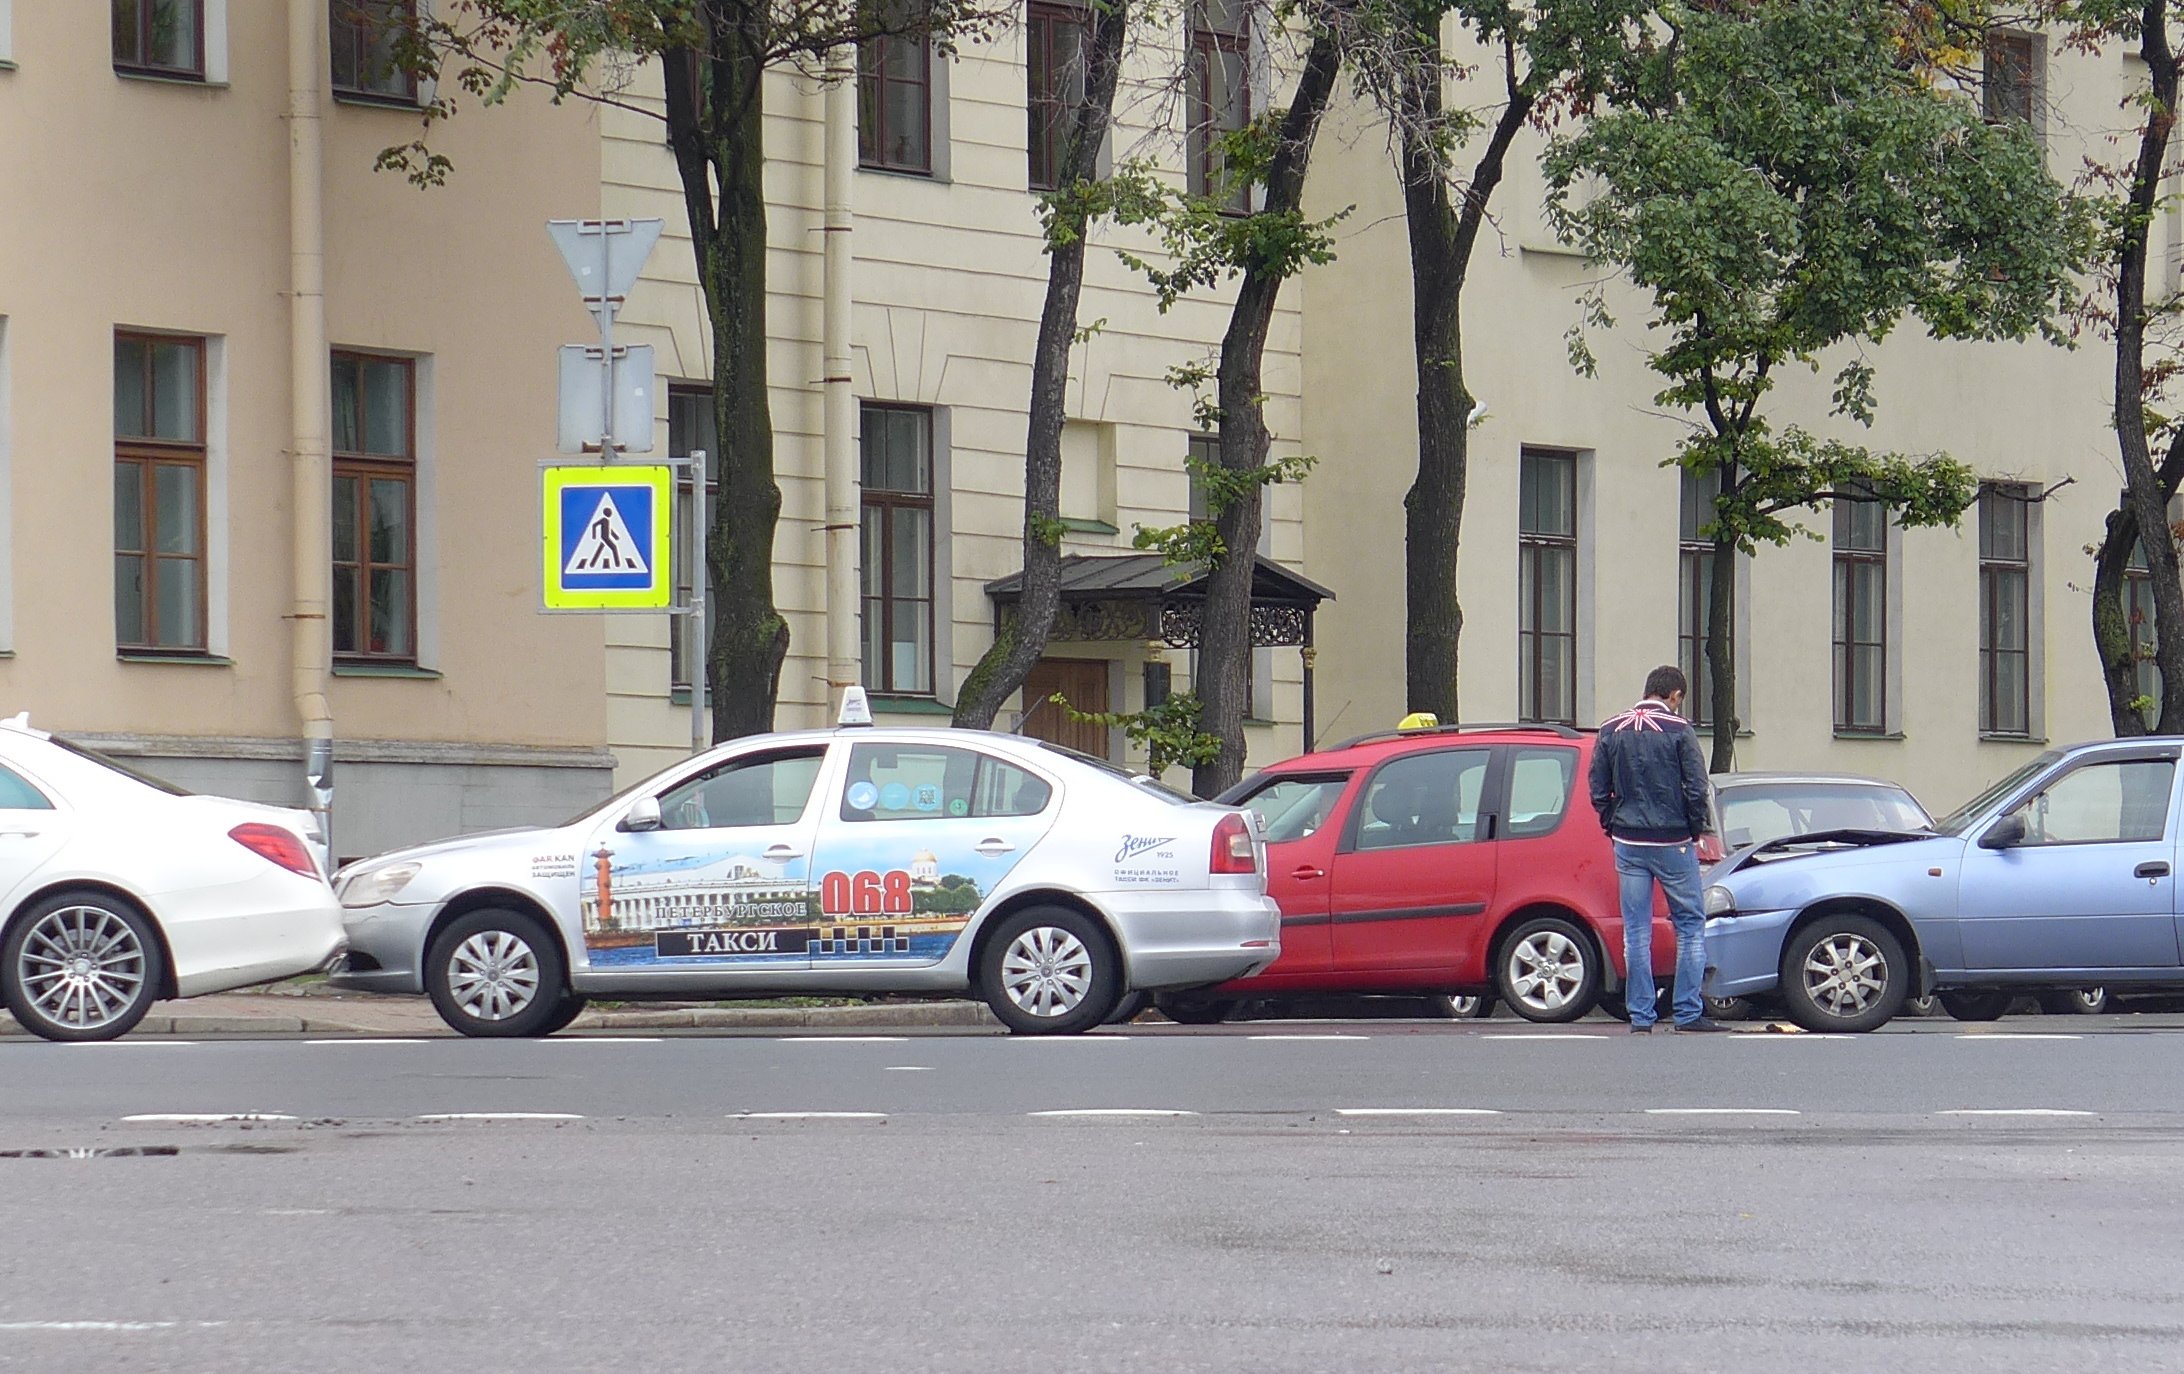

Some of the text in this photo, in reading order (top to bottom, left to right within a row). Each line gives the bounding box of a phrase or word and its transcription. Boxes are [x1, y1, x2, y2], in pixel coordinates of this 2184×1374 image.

[821, 869, 913, 915] 068
[655, 902, 807, 919] ПЕТЕРБУРГСКОЕ
[687, 931, 778, 953] ТАКСИ
